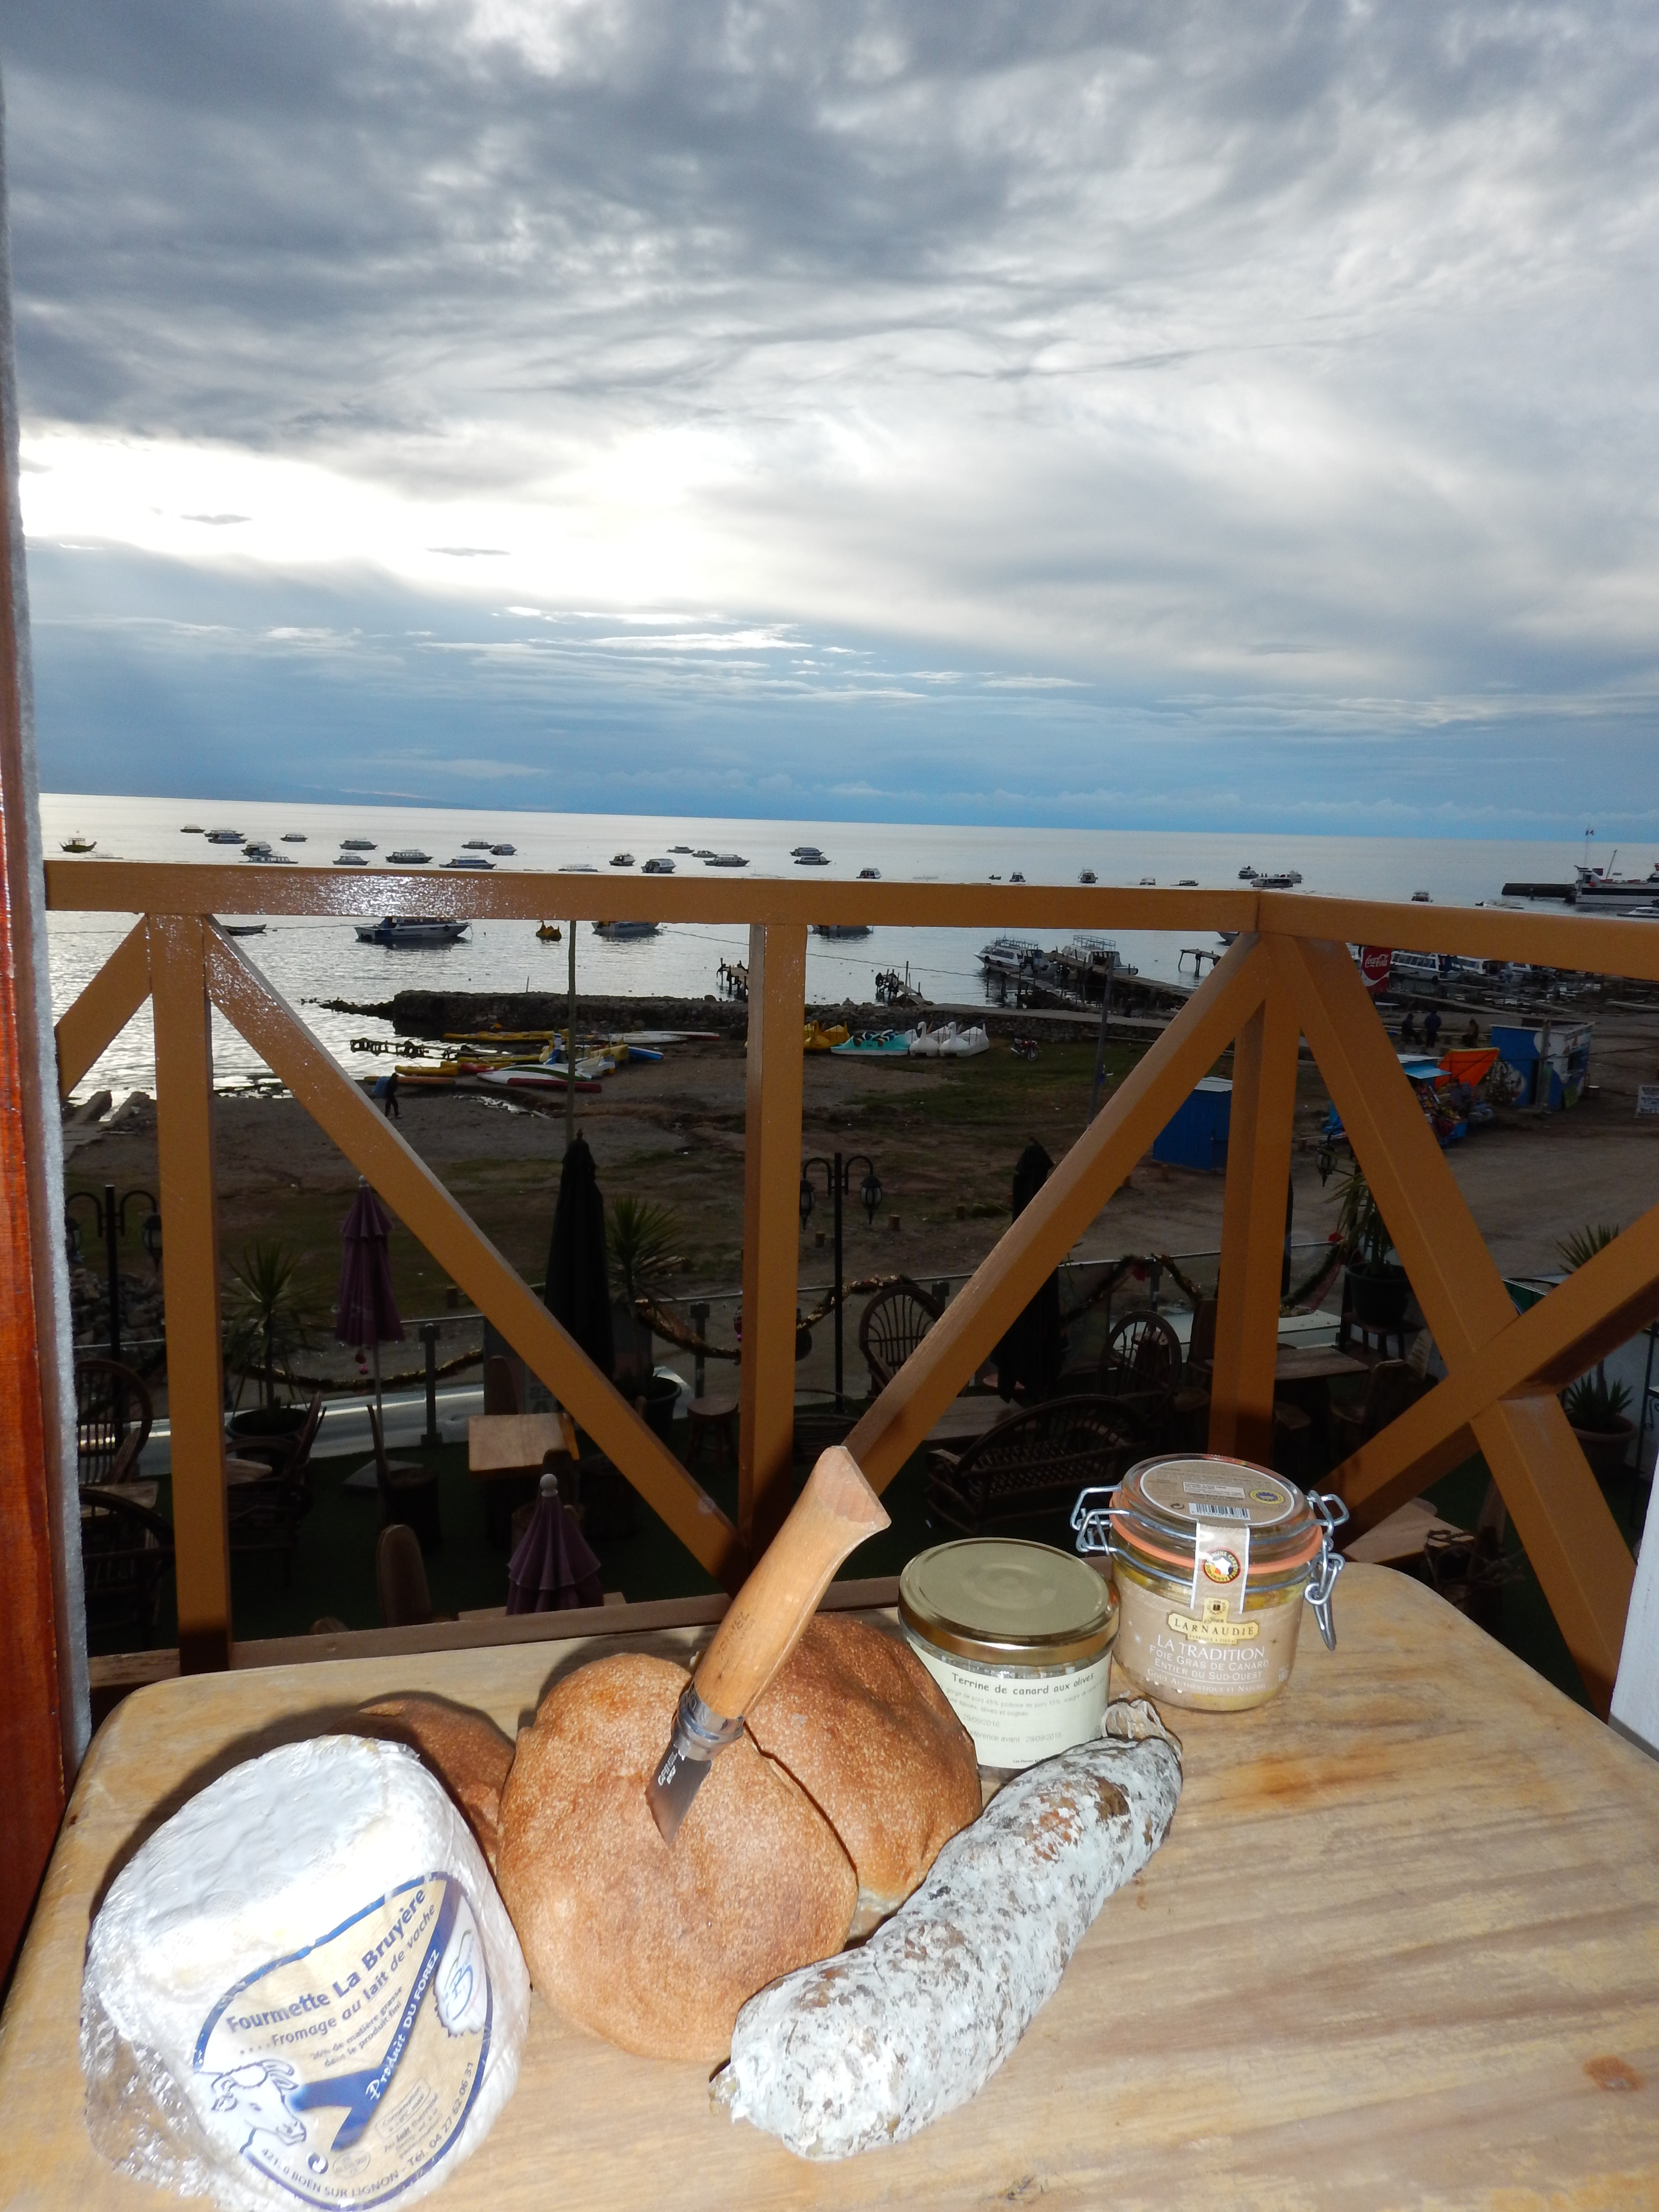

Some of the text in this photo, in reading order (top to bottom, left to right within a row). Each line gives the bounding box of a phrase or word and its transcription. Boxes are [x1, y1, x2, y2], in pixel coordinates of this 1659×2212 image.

[1175, 1618, 1254, 1635] LARNAUDIE
[1150, 1645, 1172, 1661] FOIE
[1177, 1656, 1206, 1669] GRAS
[1228, 1659, 1269, 1671] CANARD
[1157, 1635, 1265, 1661] LA TRADITION
[1155, 1659, 1263, 1681] ENTIER DU SUD-OUEST
[951, 1672, 990, 1691] Terrine
[995, 1684, 1008, 1695] de
[1013, 1683, 1049, 1695] canard
[1053, 1683, 1070, 1693] aux
[1073, 1672, 1095, 1688] olives
[1171, 1678, 1224, 1693] AUTHENTIQUE
[227, 1889, 425, 2032] Fourmette La Bruyère
[342, 1999, 361, 2020] au
[363, 1971, 389, 2000] lait
[390, 1950, 405, 1972] de
[407, 1904, 435, 1948] vache
[333, 2043, 345, 2051] de
[347, 2015, 378, 2044] matière
[380, 1986, 402, 2016] grasse
[365, 1948, 440, 2101] Produit DU FOREZ
[325, 2054, 346, 2067] dans
[348, 2046, 357, 2055] le
[359, 2017, 389, 2049] produit
[263, 2149, 290, 2175] 4210
[325, 2186, 348, 2198] SUR
[351, 2169, 399, 2197] LIGNON
[429, 2133, 442, 2148] 04
[441, 2116, 453, 2133] 27
[452, 2098, 462, 2115] 62
[459, 2079, 469, 2096] 06
[464, 2062, 474, 2077] 31
[396, 2127, 410, 2142] lait
